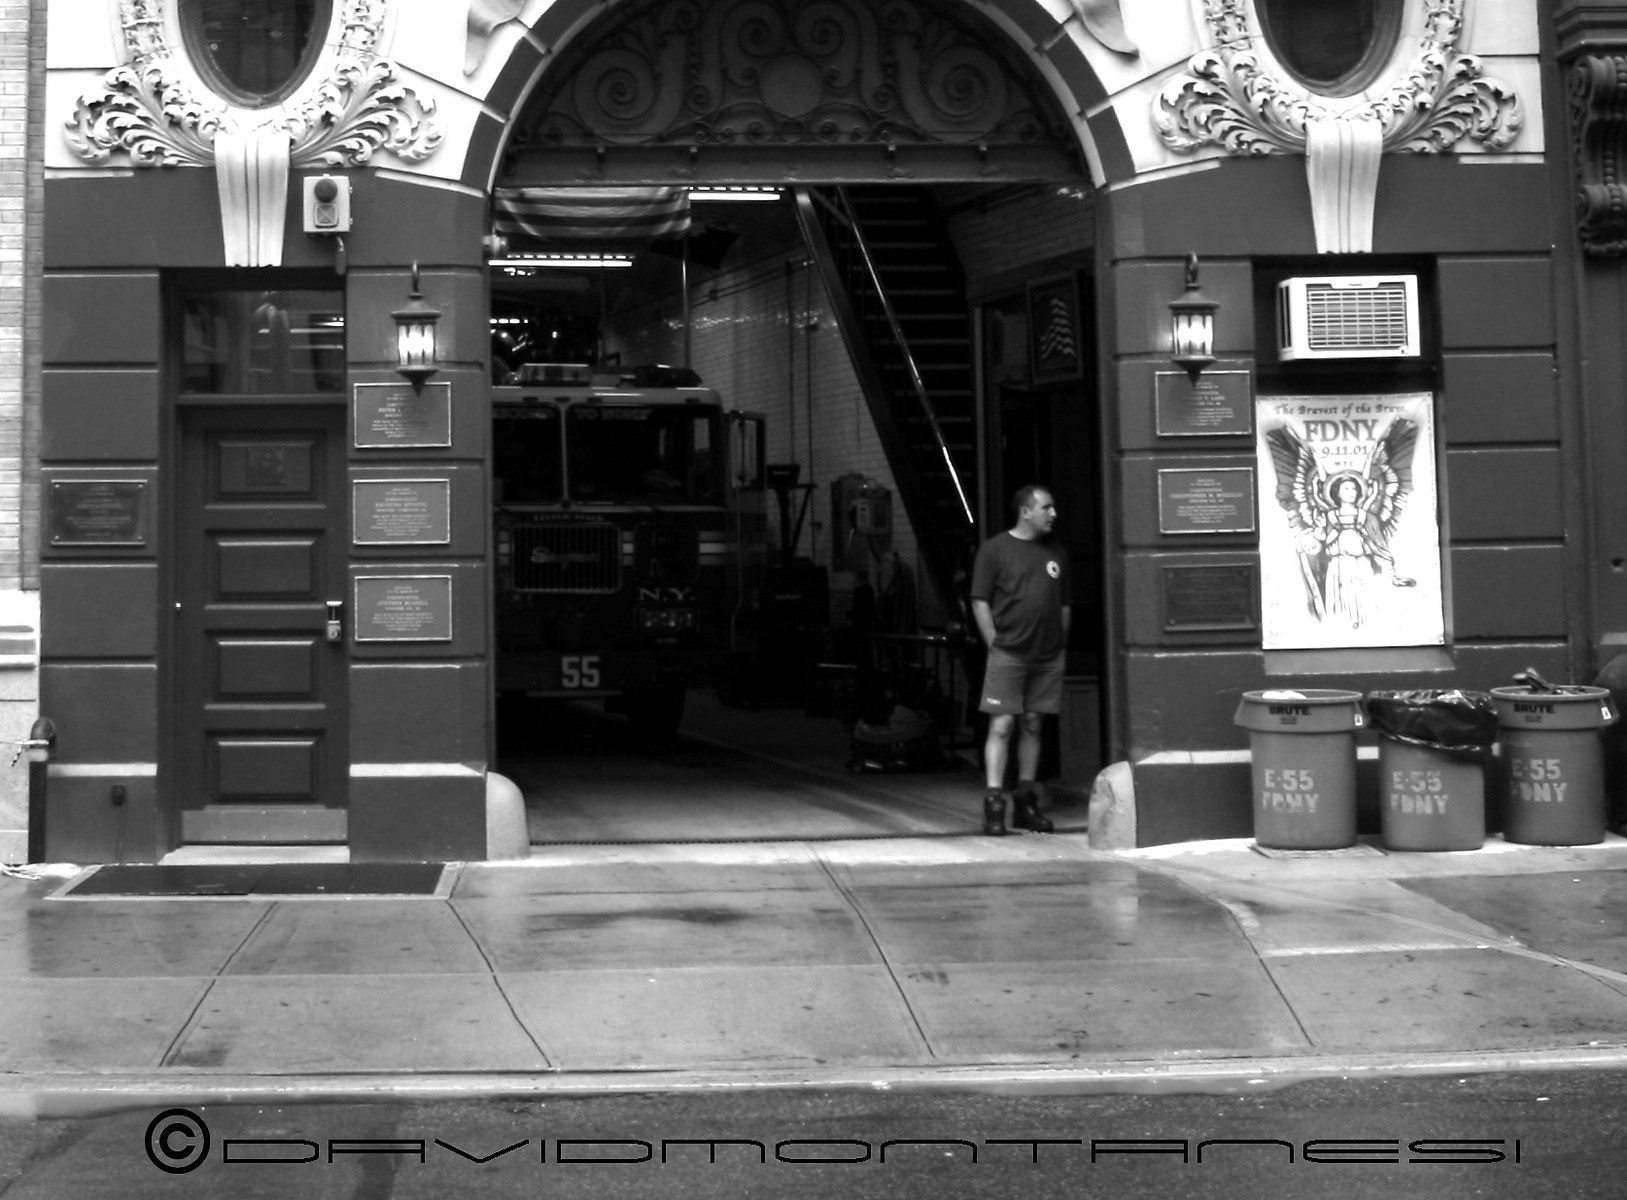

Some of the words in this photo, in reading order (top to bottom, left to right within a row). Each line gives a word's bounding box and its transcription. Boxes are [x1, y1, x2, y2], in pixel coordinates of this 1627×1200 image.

[1274, 403, 1294, 415] The
[1299, 405, 1338, 415] Bravest
[1341, 403, 1352, 418] of
[1355, 402, 1371, 415] the
[1302, 419, 1379, 443] FDNY
[1321, 445, 1370, 458] 9.11.01
[561, 655, 600, 688] 55
[1268, 705, 1310, 716] BRUTE
[1513, 703, 1555, 714] BRUTE
[1262, 791, 1319, 813] FDNY
[1390, 793, 1449, 815] FDNY
